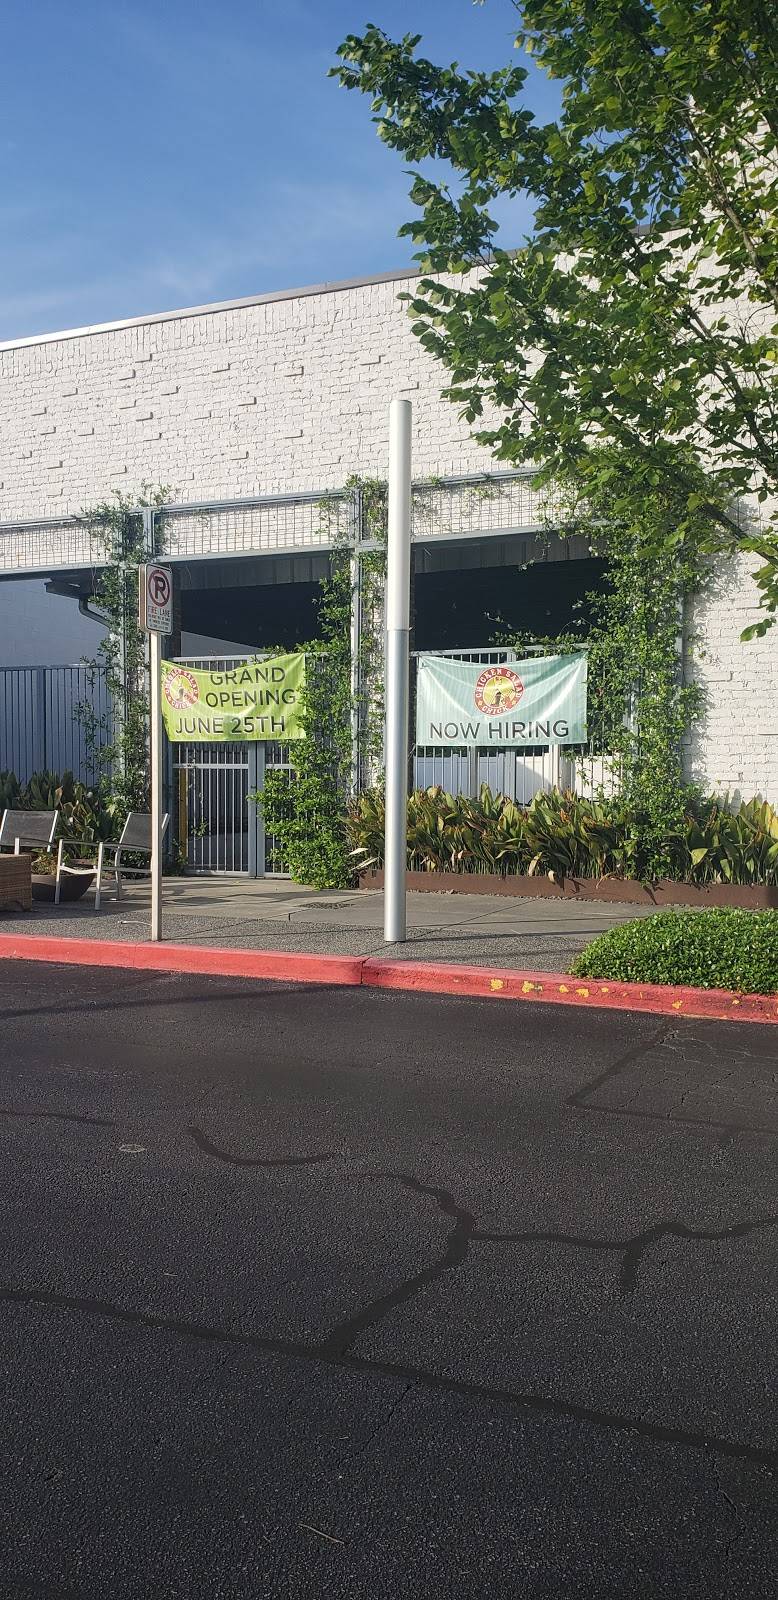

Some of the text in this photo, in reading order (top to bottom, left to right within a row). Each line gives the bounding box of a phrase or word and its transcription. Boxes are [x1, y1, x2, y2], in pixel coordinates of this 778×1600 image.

[210, 667, 286, 685] GRAND
[476, 669, 502, 698] CHICKEN
[205, 688, 296, 708] OPENING
[481, 705, 508, 715] CHICK
[175, 716, 285, 734] JUNE 25TH
[430, 720, 569, 739] NOW HIRING
